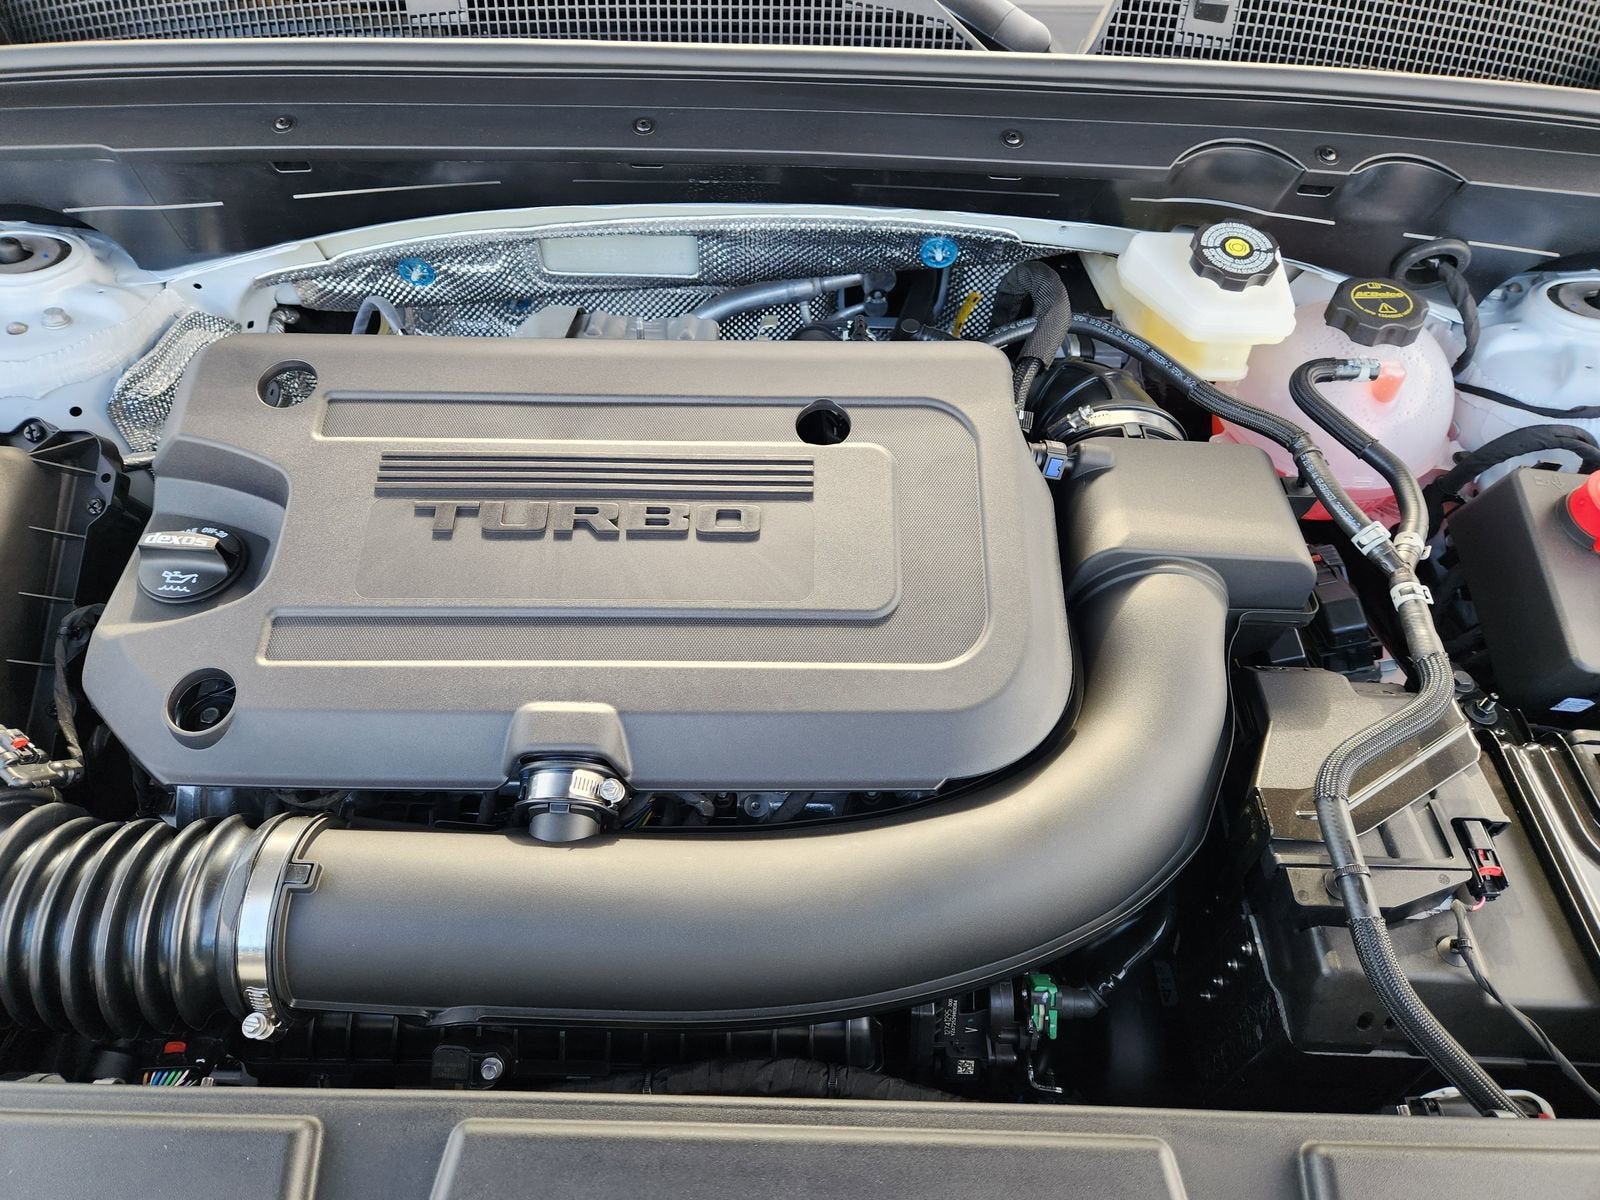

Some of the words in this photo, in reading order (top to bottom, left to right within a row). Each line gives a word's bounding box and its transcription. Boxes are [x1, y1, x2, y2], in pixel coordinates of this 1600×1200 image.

[414, 500, 761, 542] TURBO
[144, 532, 208, 547] dexos
[201, 527, 229, 538] 0W-20
